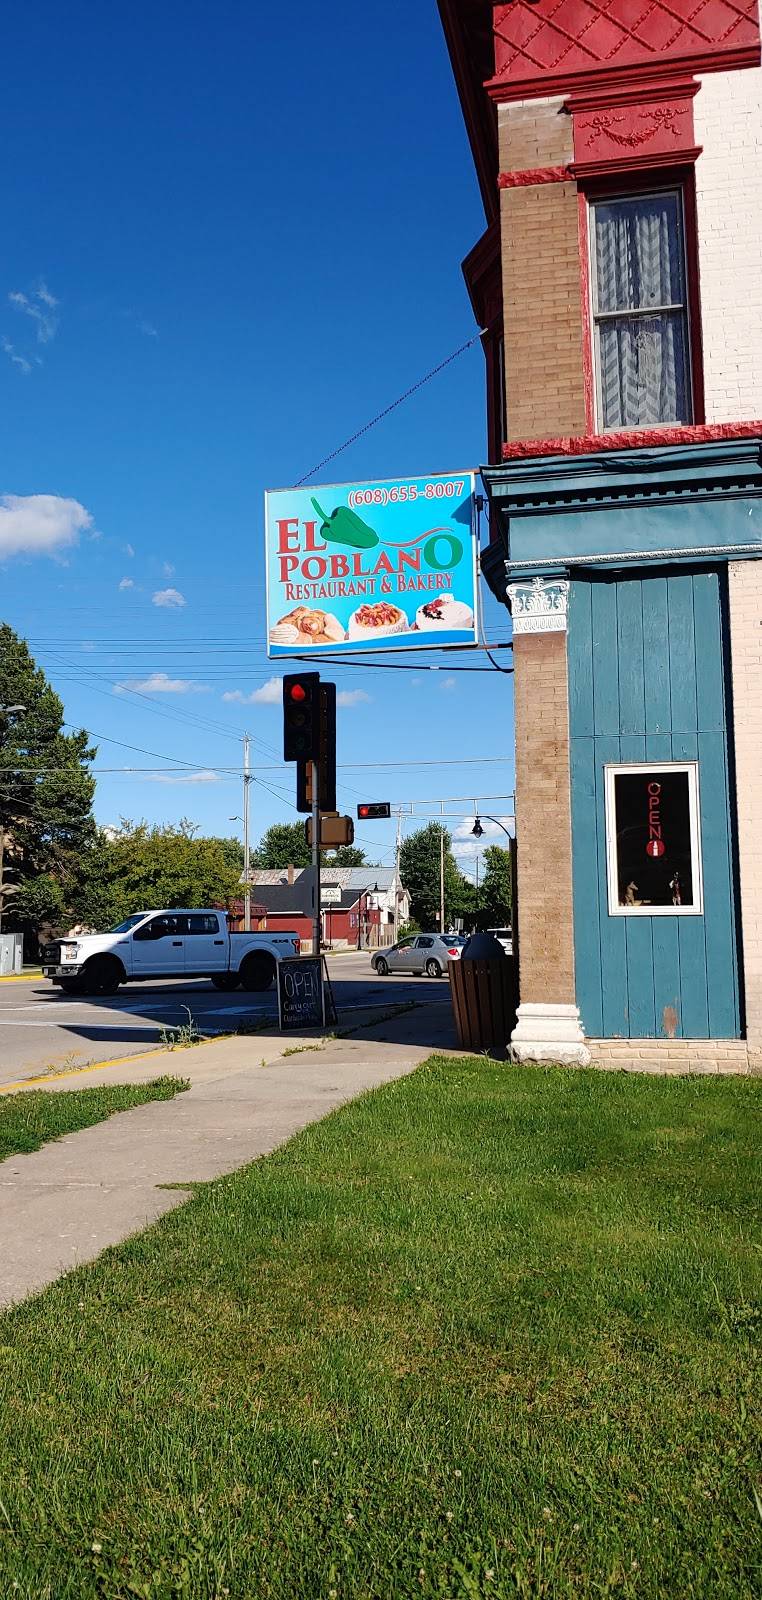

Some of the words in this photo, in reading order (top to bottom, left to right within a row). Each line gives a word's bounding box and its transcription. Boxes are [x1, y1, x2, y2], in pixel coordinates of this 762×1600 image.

[349, 482, 464, 507] (608)655-8007
[276, 518, 327, 554] EL
[278, 534, 463, 582] POBLANO
[286, 579, 376, 600] RESTAURANT
[381, 577, 392, 593] &
[397, 573, 454, 592] BAKERY
[648, 782, 661, 839] OPEN
[284, 969, 319, 998] OPEN
